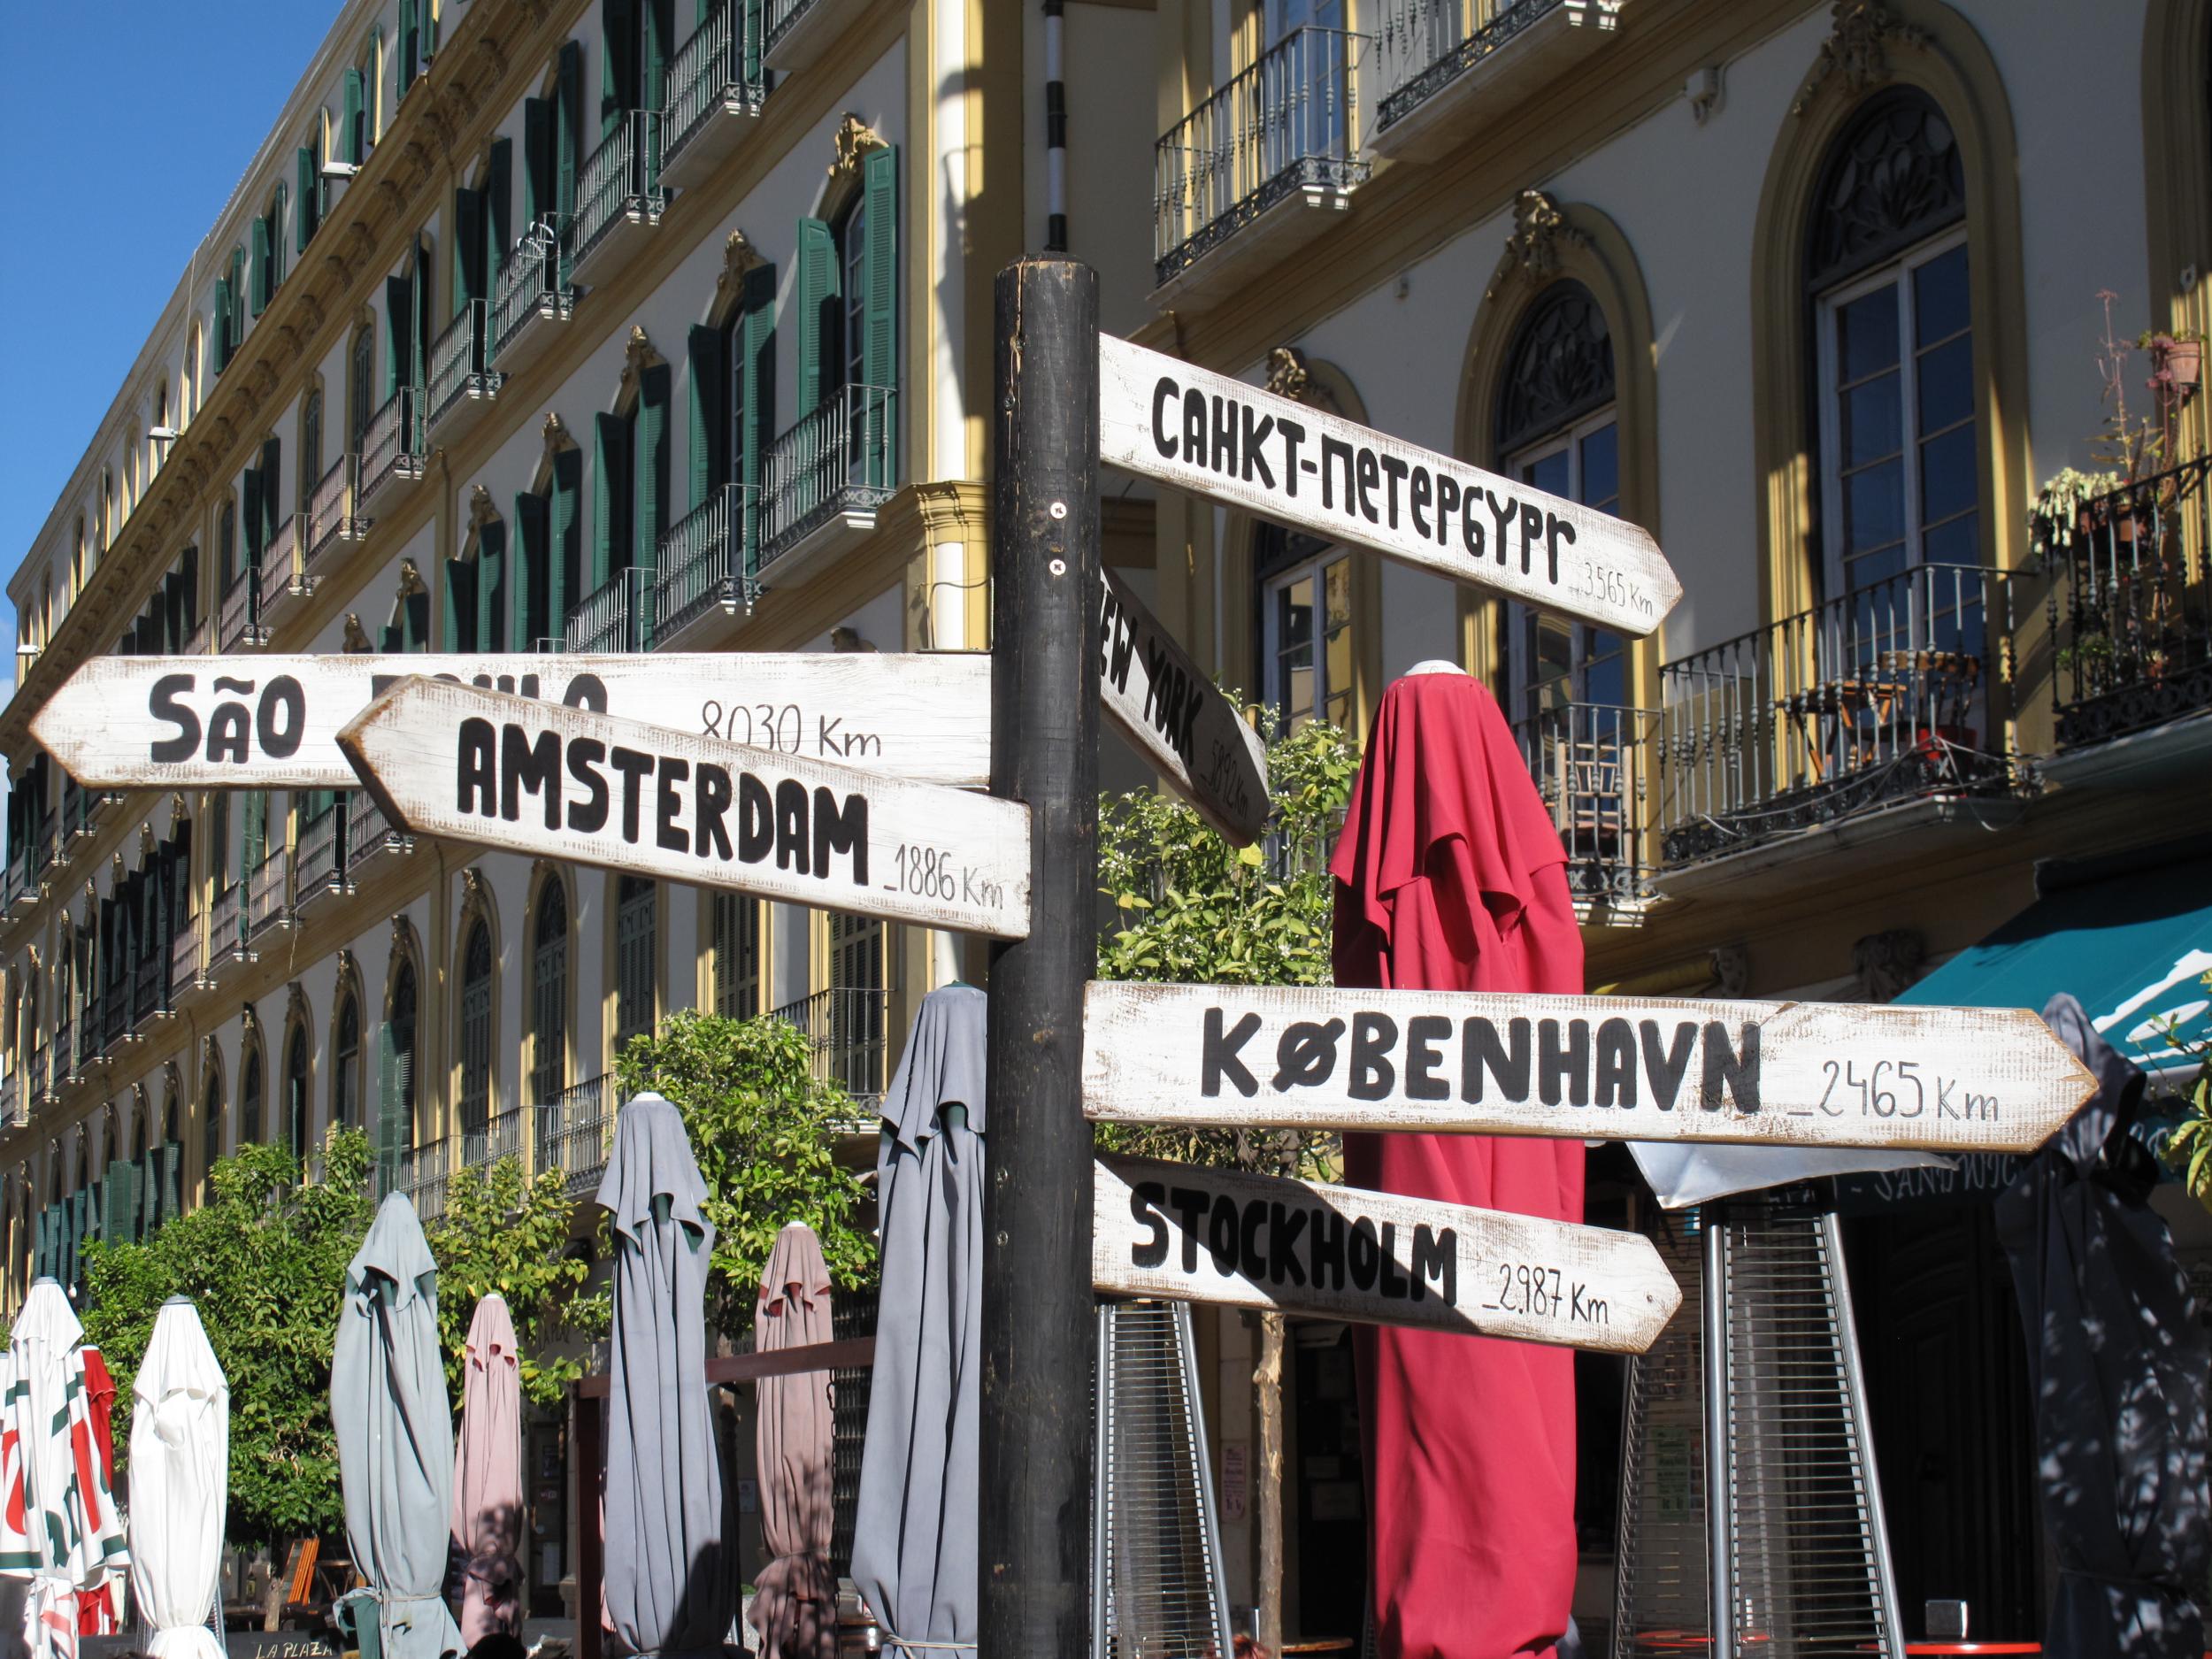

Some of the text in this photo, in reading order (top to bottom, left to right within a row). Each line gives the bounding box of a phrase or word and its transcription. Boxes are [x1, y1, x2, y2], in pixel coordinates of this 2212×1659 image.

[1630, 582, 1653, 617] Km
[1100, 580, 1203, 767] EW YORK
[149, 673, 306, 764] SÃO
[702, 700, 881, 757] 8030 Km
[457, 717, 869, 886] AMSTERDAM
[963, 865, 1003, 910] Km
[1201, 1007, 1762, 1115] KØBENHAVN
[1937, 1076, 1999, 1123] Km
[1130, 1181, 1457, 1309] STOCKHOLM
[1571, 1282, 1609, 1325] Km
[283, 1640, 334, 1659] PLAZA
